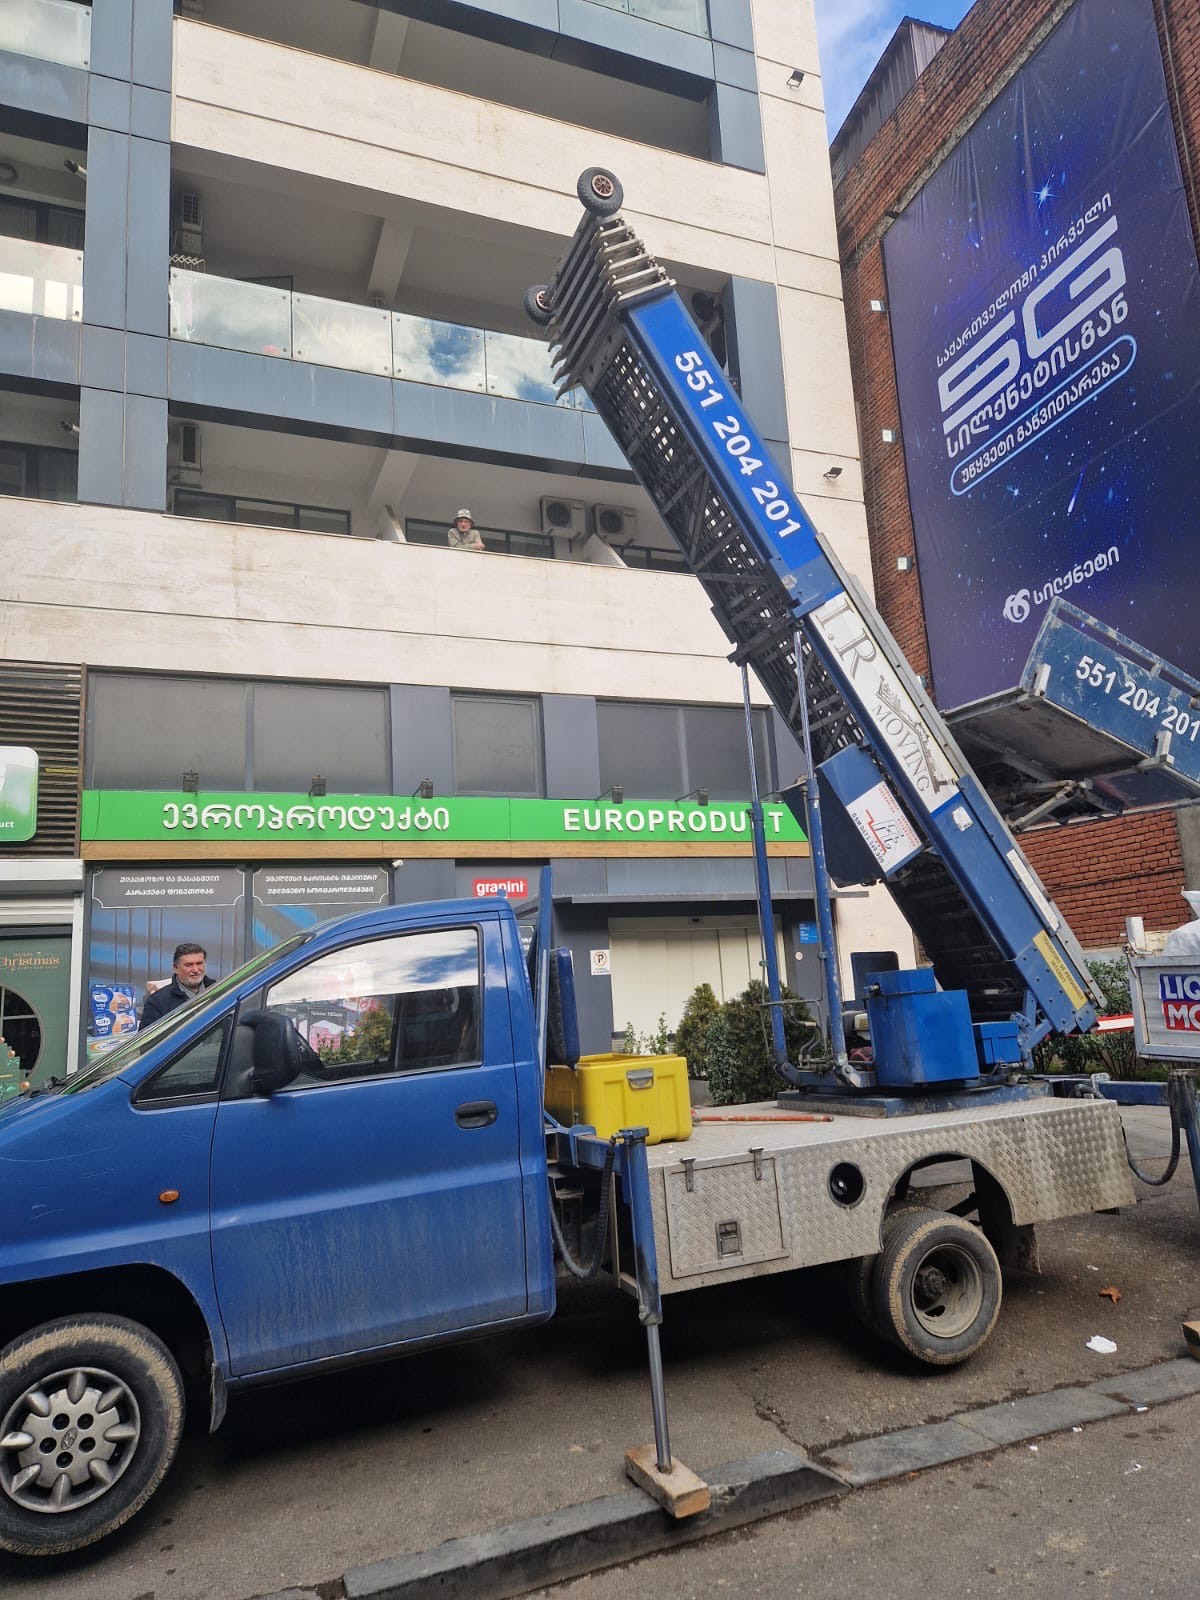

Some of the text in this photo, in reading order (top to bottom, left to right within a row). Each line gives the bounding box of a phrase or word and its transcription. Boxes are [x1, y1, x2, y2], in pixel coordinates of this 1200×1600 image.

[936, 192, 1112, 368] საქართველოში პირველი
[946, 292, 1128, 458] სილქნეტისგან
[961, 352, 1121, 484] უწყვეტი განვითარება
[675, 351, 801, 538] 551 204 201
[1032, 546, 1121, 605] სილქნეტი
[1076, 655, 1200, 742] 551 204 201
[872, 703, 930, 793] MOVING
[162, 803, 450, 831] ევროპროდუქტი
[563, 808, 784, 833] EUROPRODUT
[476, 880, 524, 896] granini
